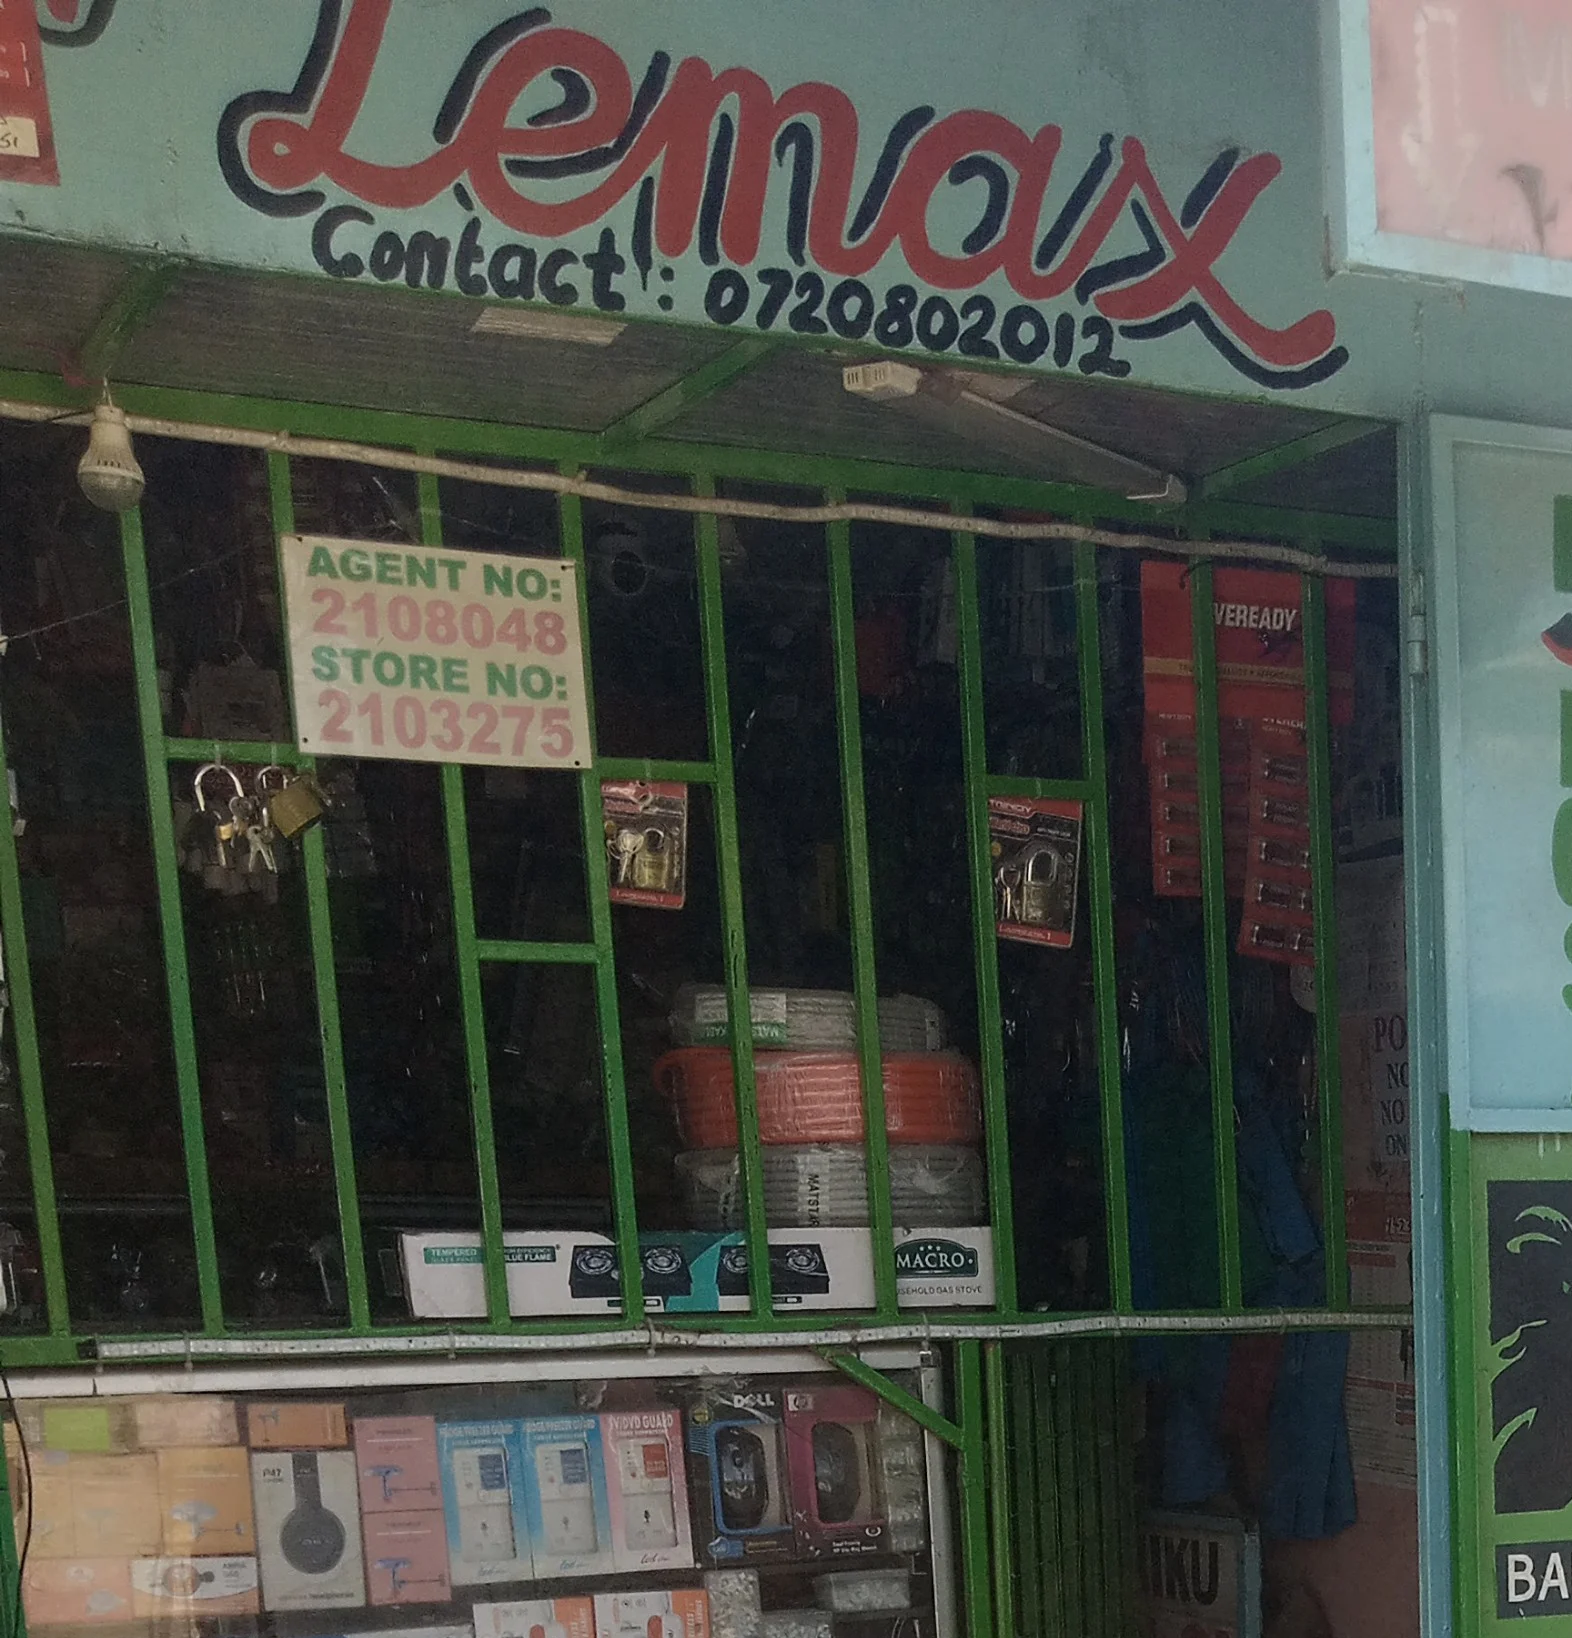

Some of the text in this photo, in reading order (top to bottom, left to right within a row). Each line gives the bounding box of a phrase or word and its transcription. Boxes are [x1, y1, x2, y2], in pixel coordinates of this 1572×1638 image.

[218, 0, 1349, 389] Lemax
[703, 268, 1132, 377] 0720802012
[307, 545, 562, 602] AGENT NO:
[310, 589, 568, 657] 2108048
[1212, 601, 1298, 632] VEREADY
[311, 646, 568, 701] STORE NO:
[318, 688, 574, 758] 2103275
[896, 1252, 965, 1268] MACRO
[897, 1286, 935, 1295] SEHOLD
[733, 1393, 775, 1408] DELL
[262, 1468, 282, 1478] P47
